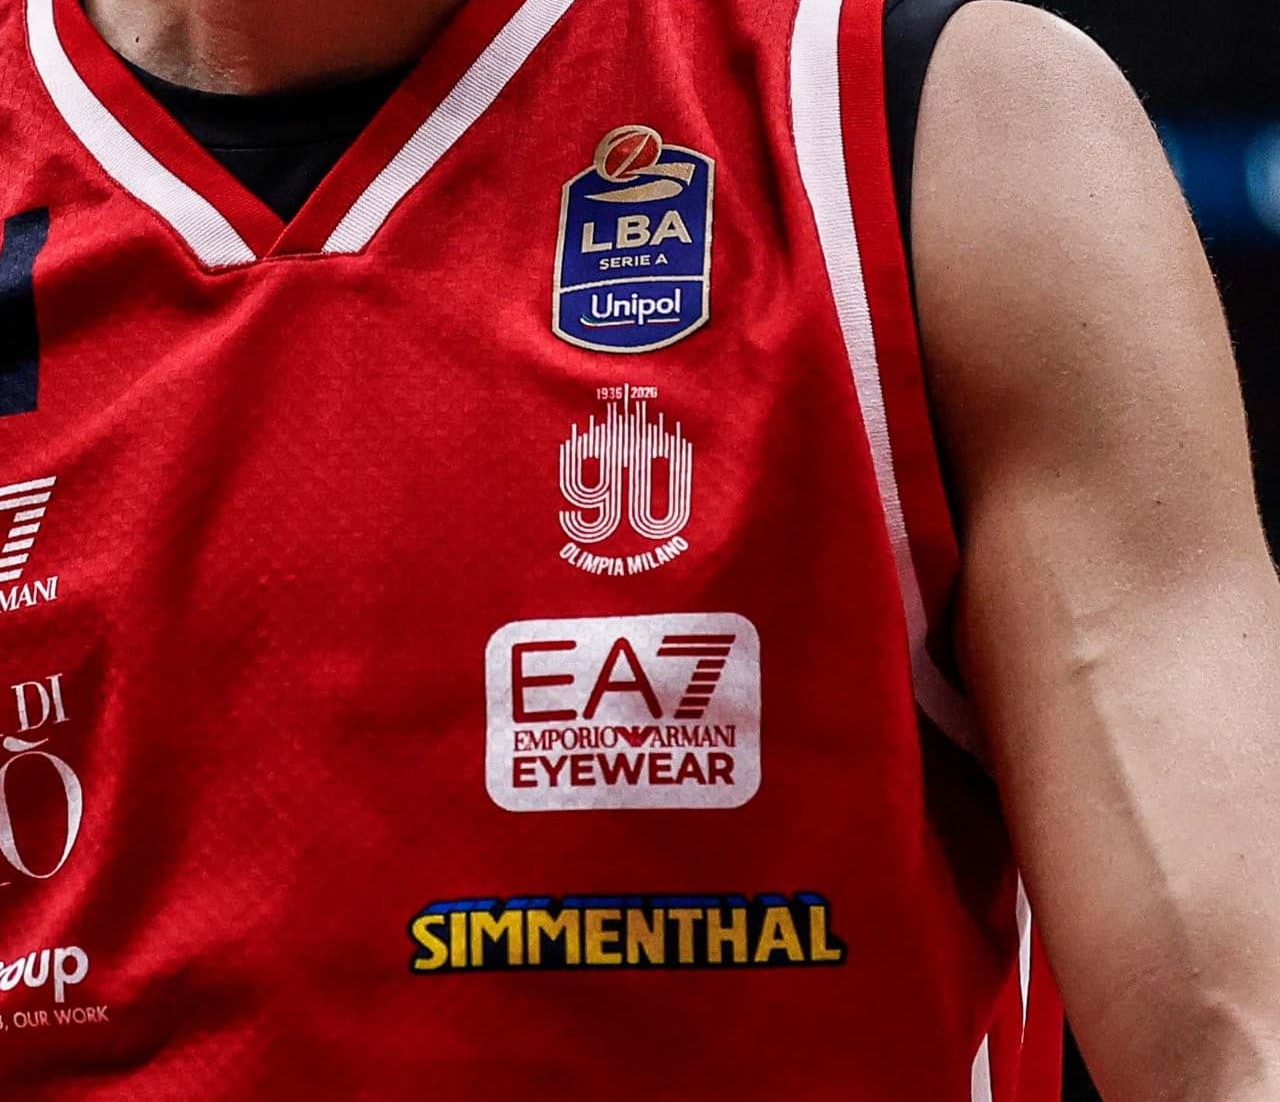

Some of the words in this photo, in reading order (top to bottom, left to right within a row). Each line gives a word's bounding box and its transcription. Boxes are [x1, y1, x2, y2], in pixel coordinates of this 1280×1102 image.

[581, 210, 692, 253] LBA
[599, 255, 651, 270] SERIE
[655, 253, 668, 265] A
[591, 288, 681, 325] Unipol
[559, 398, 692, 543] 90
[559, 542, 624, 576] OLIMPIA
[627, 535, 689, 575] MILANO
[512, 635, 736, 723] EA7
[11, 673, 70, 733] DI
[514, 726, 618, 751] EMPORIO
[650, 725, 736, 747] ARMANI
[513, 752, 735, 788] EYEWEAR
[410, 895, 844, 971] SIMMENTHAL
[13, 1010, 50, 1028] OUR
[53, 1005, 110, 1025] WORK
